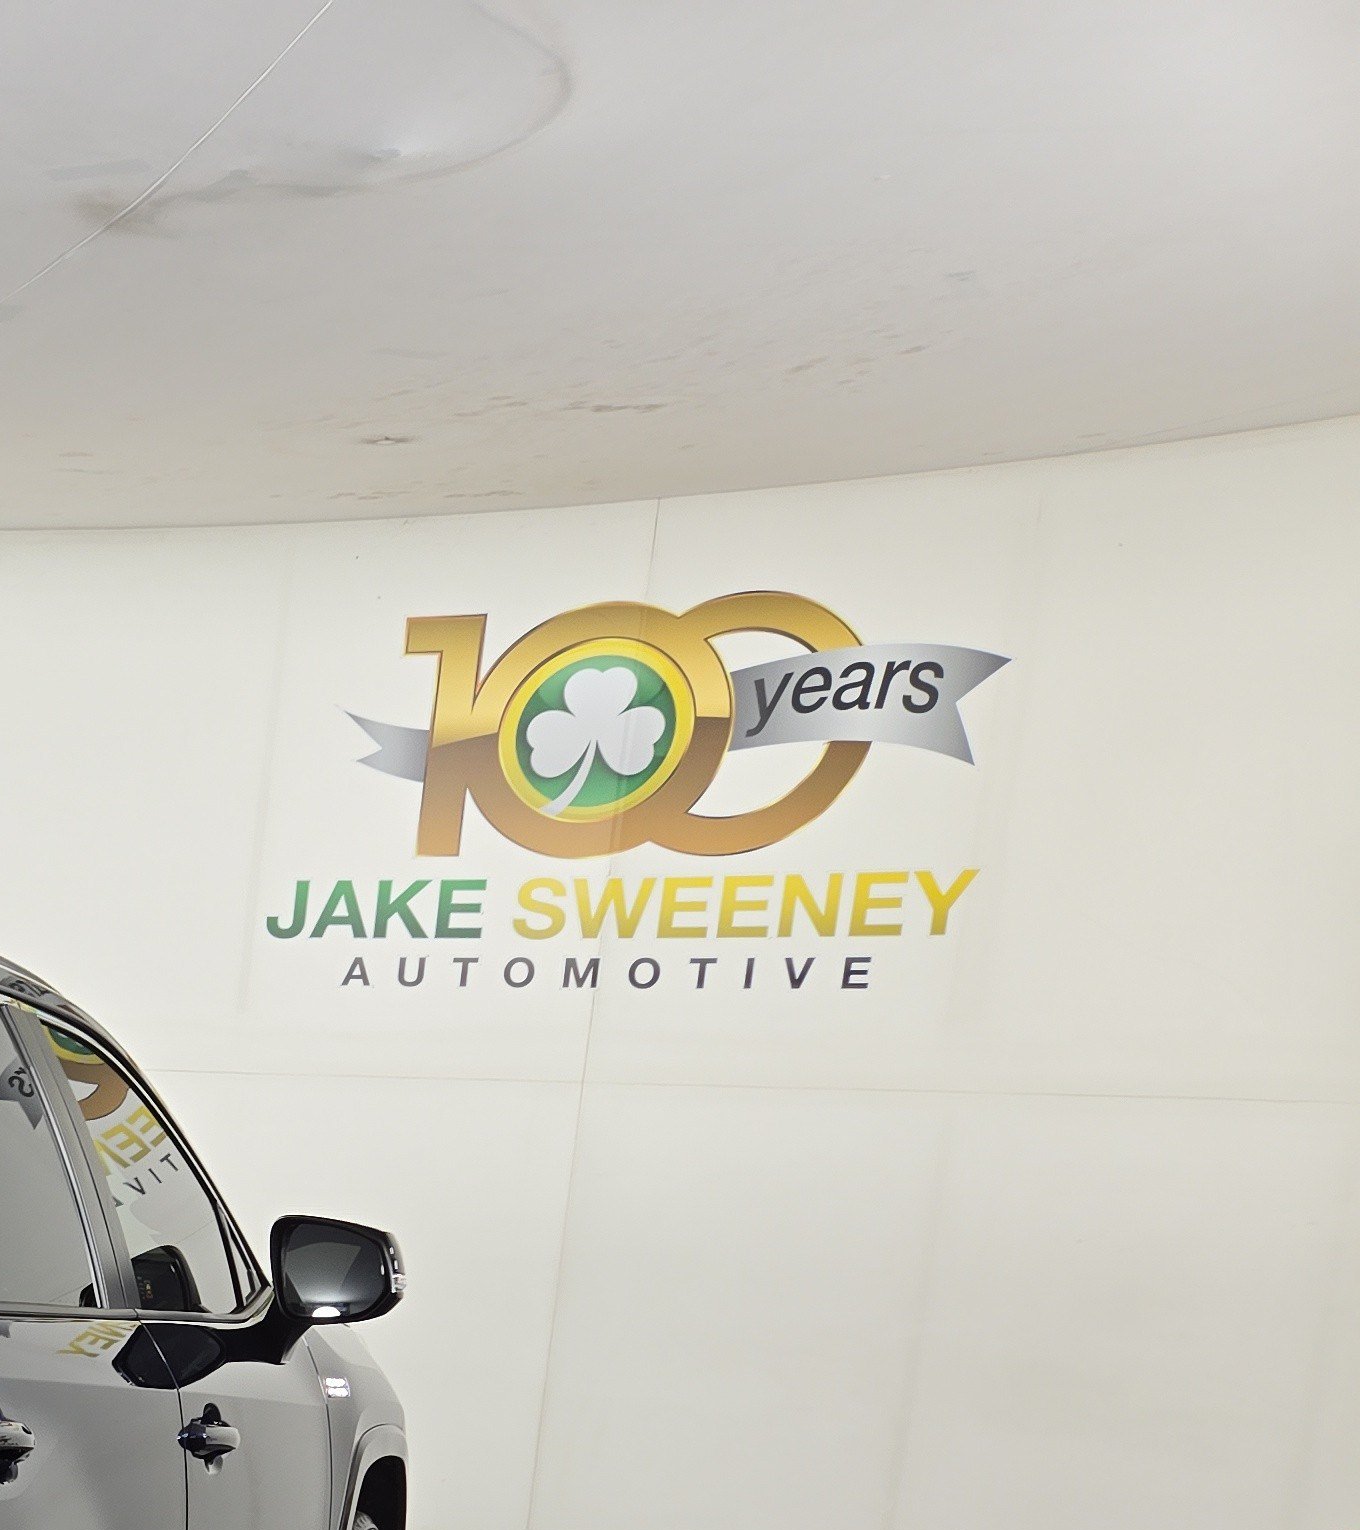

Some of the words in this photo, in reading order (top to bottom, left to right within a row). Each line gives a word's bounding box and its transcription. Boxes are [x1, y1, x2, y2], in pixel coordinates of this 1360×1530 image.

[745, 659, 944, 737] years
[266, 878, 488, 940] JAKE
[512, 868, 980, 940] SWEENEY
[342, 955, 873, 991] AUTOMOTIVE
